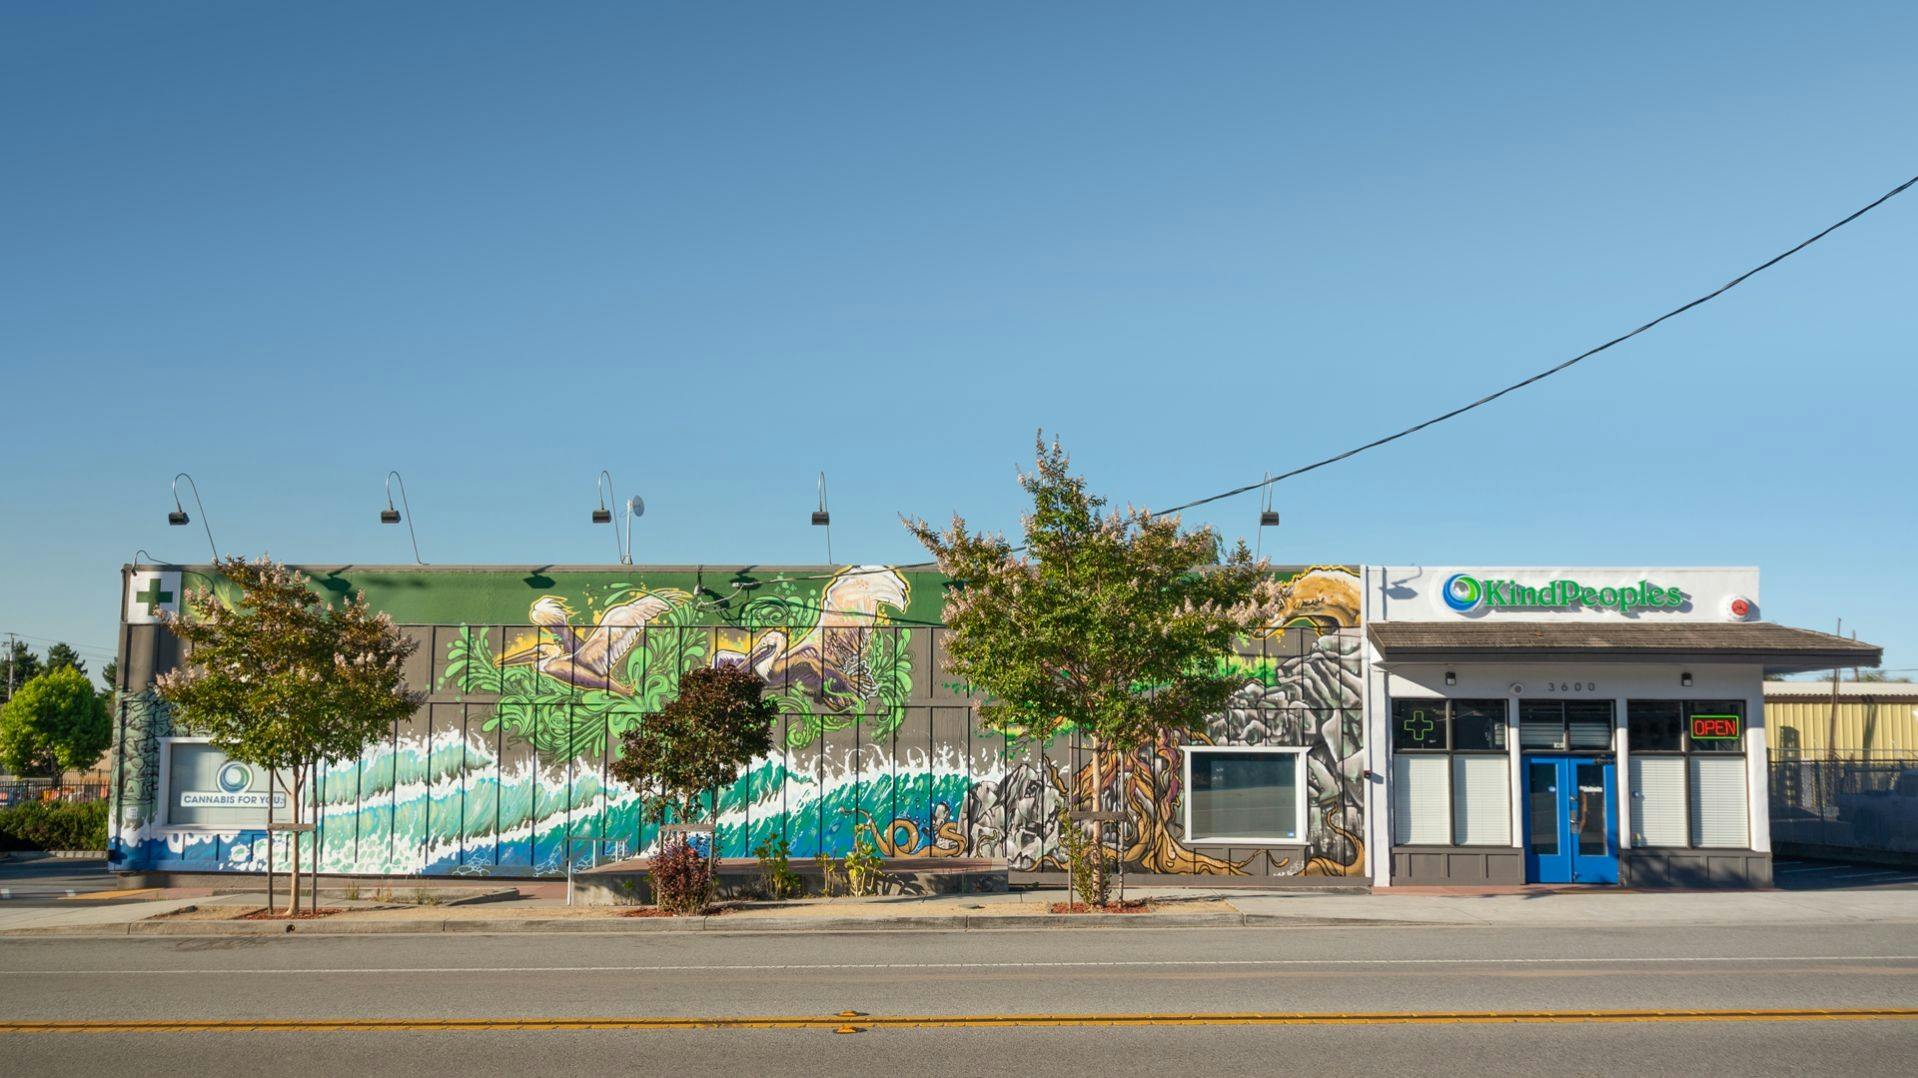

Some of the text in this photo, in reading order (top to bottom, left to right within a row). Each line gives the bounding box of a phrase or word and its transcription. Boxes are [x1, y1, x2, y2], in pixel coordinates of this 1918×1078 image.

[1484, 579, 1682, 613] KindPeoples
[1548, 682, 1596, 692] 3600
[1694, 719, 1736, 736] OPEN
[183, 795, 235, 804] CANNABIS
[238, 796, 257, 804] FOR
